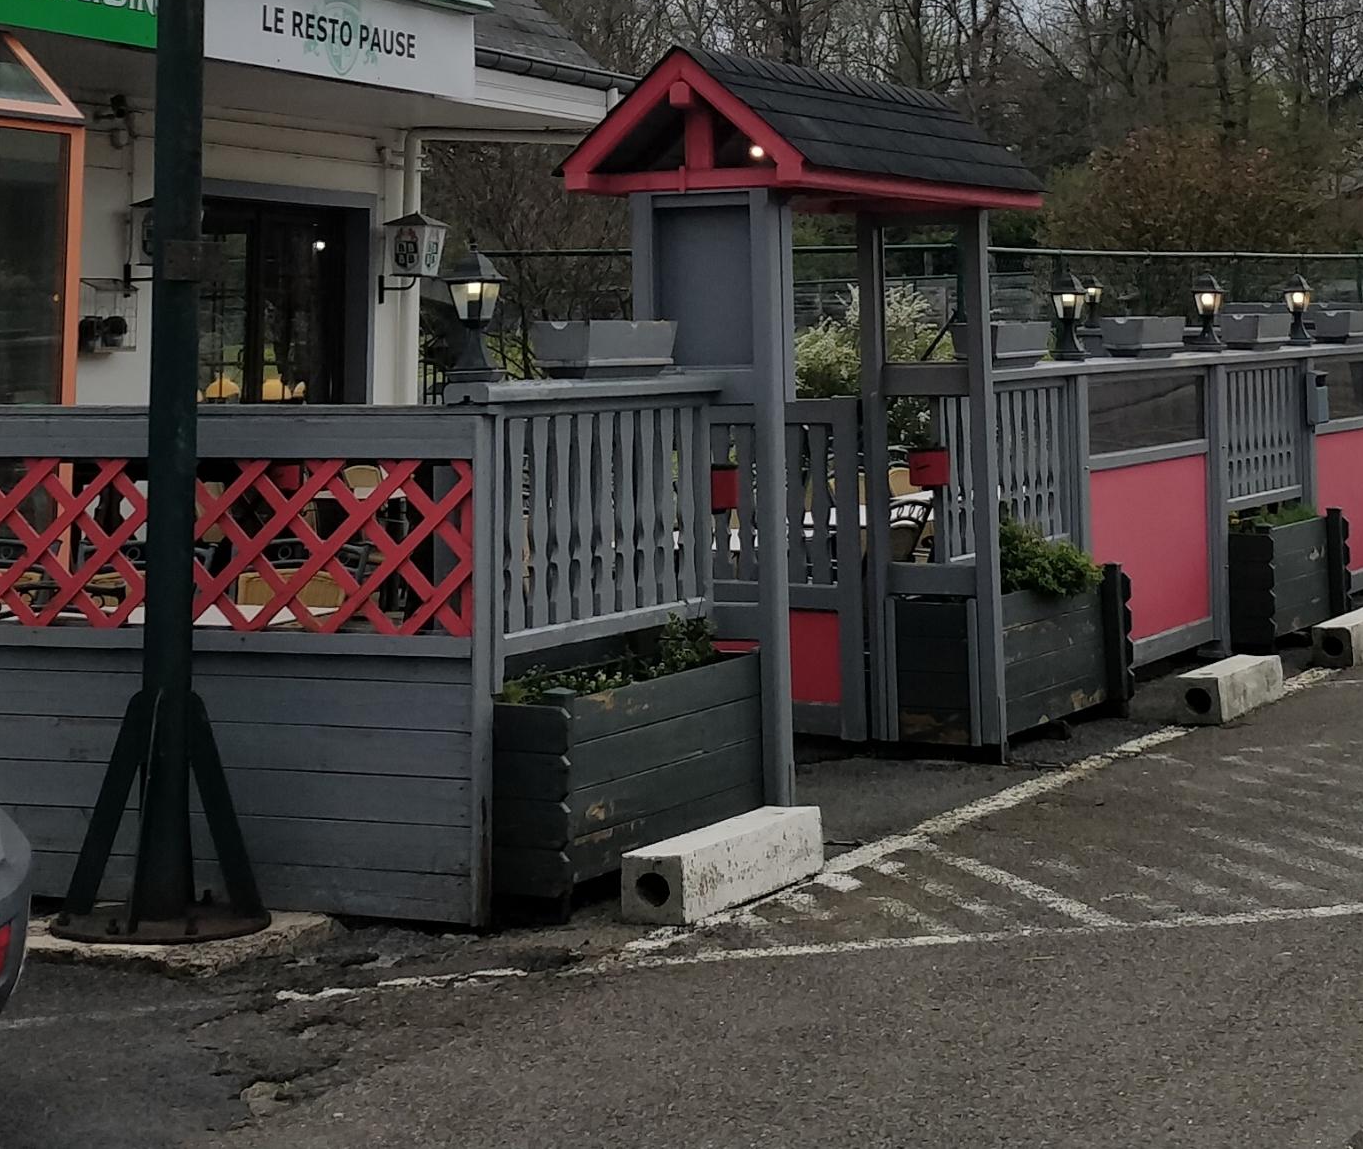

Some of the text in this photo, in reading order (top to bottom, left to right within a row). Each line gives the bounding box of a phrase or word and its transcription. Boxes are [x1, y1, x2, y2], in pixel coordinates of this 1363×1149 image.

[262, 5, 416, 59] LE RESTO PAUSE
